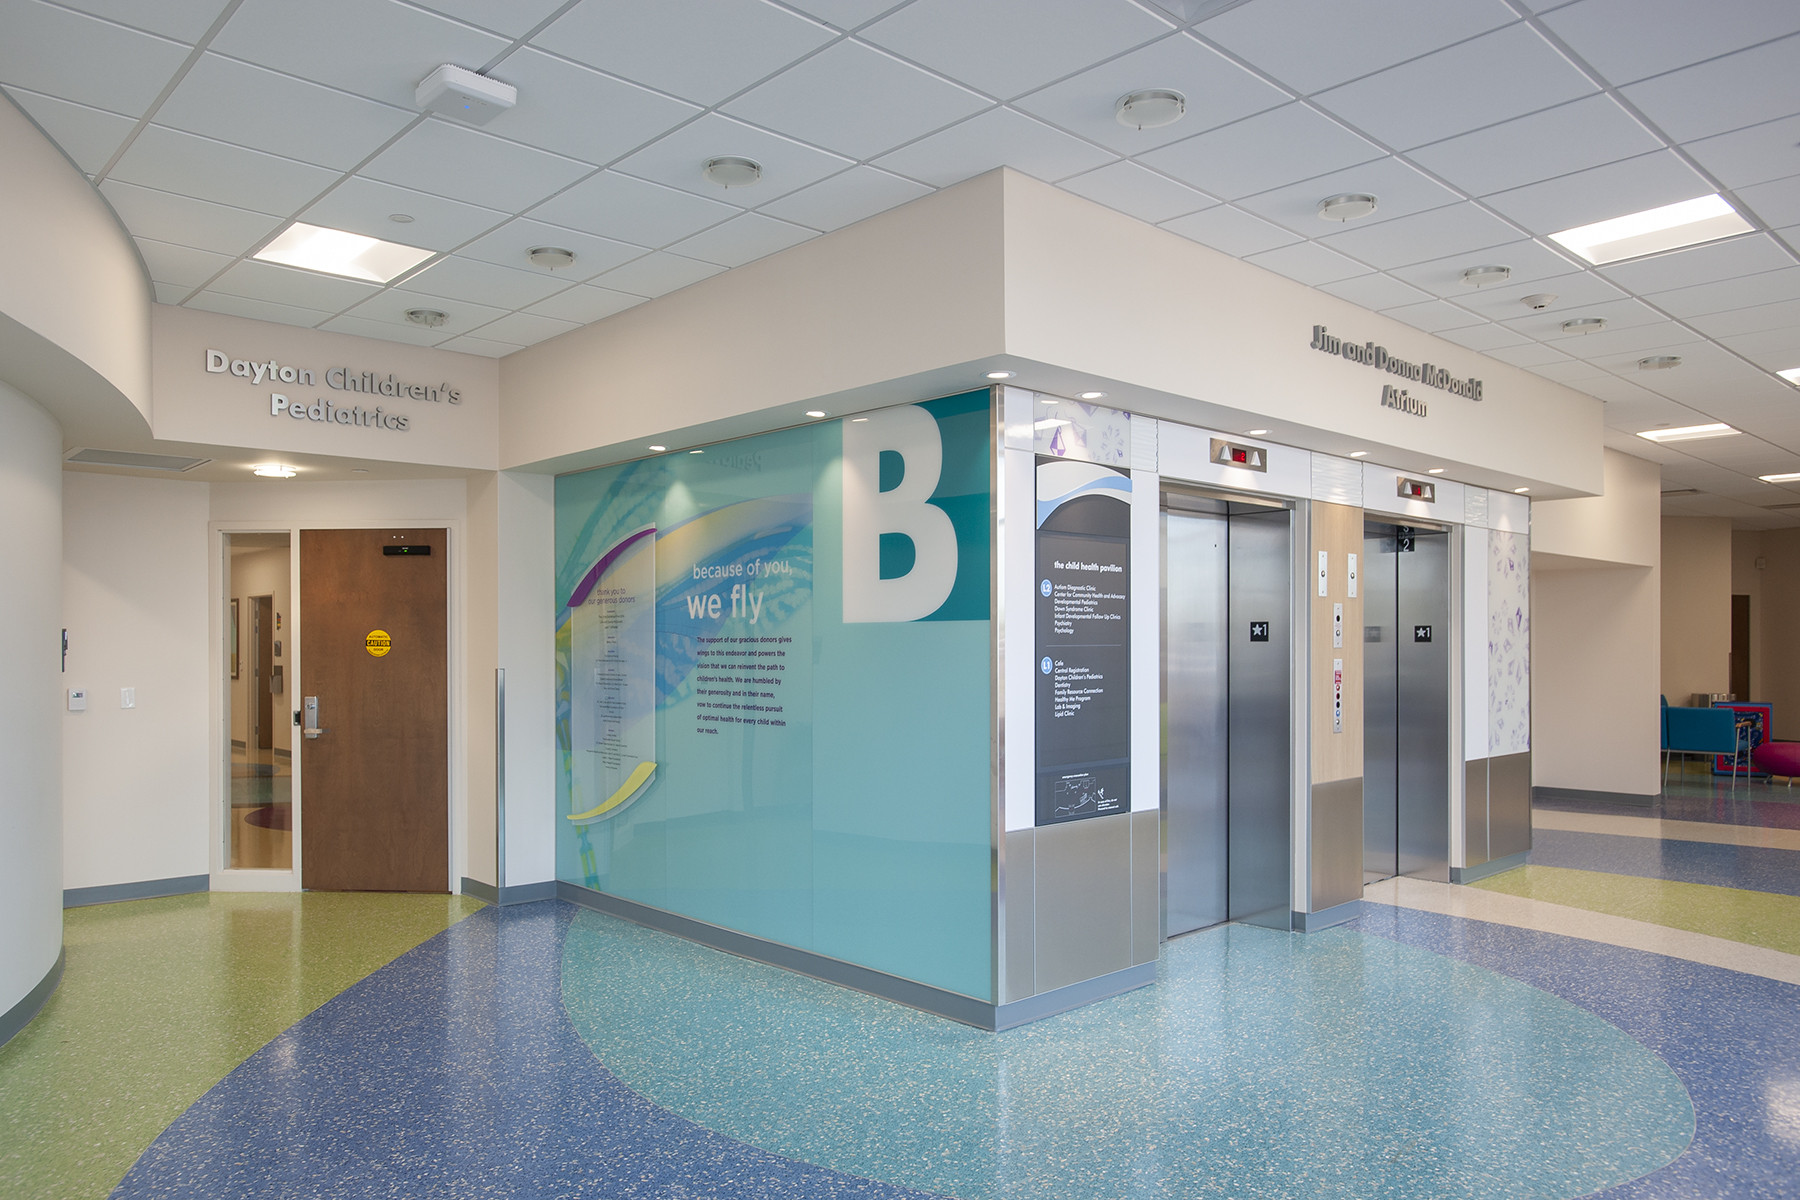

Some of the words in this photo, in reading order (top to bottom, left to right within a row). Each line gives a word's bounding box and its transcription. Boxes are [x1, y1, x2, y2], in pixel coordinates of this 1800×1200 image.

[1310, 325, 1342, 355] Jim
[1342, 342, 1375, 365] and
[1375, 346, 1421, 381] Donna
[1421, 363, 1483, 401] McDonald
[205, 348, 316, 385] Dayton
[325, 367, 462, 405] Children's
[1381, 384, 1427, 417] Atrium
[270, 393, 410, 431] Pediatrics
[842, 405, 958, 623] B
[1403, 538, 1410, 552] 2
[693, 563, 742, 579] because
[747, 559, 760, 576] of
[764, 560, 792, 578] you,
[1054, 560, 1064, 569] the
[1065, 561, 1080, 570] child
[1080, 562, 1099, 571] health
[1100, 564, 1122, 573] pavilion
[1042, 584, 1051, 592] L2
[597, 597, 617, 605] generous
[619, 596, 635, 604] donors
[687, 594, 721, 619] we
[730, 584, 764, 624] fly
[778, 636, 792, 644] gives
[1043, 661, 1050, 669] L1
[708, 689, 731, 697] generosity
